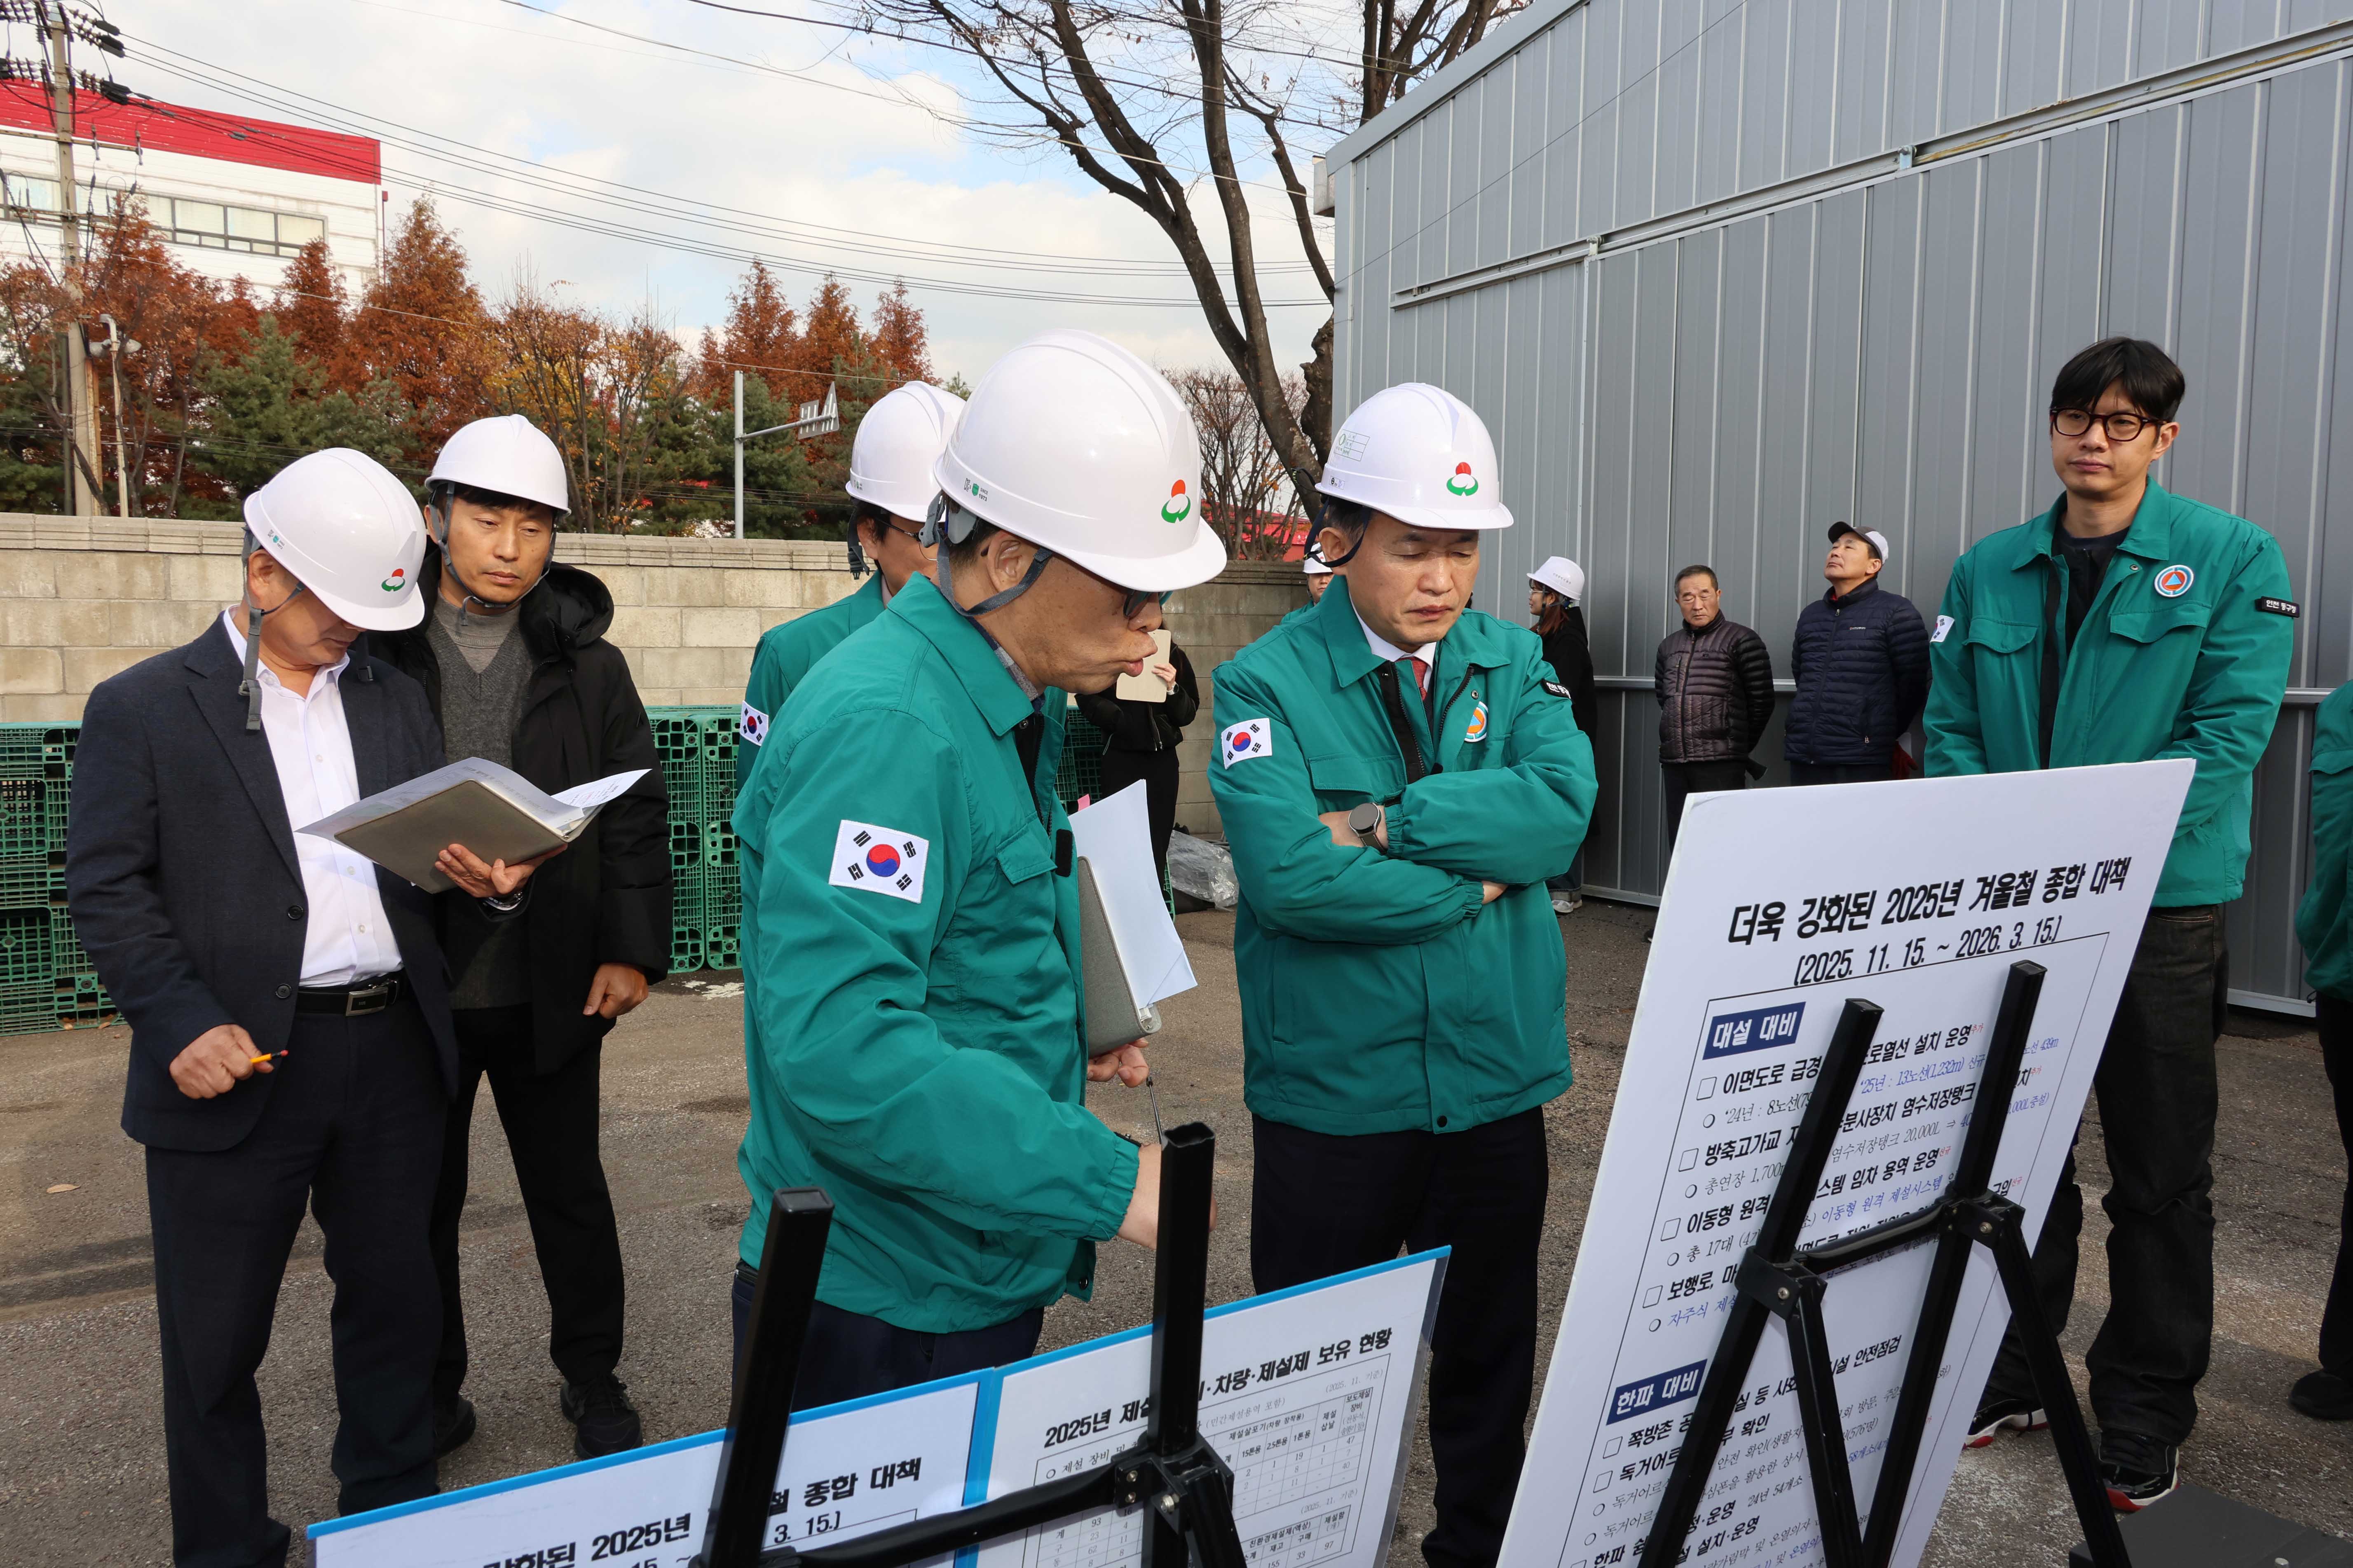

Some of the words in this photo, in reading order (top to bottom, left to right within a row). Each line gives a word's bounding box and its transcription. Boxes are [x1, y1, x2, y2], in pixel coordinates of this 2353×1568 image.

[2266, 600, 2279, 608] 인천
[2281, 603, 2296, 613] 동구청
[1728, 901, 1786, 945] 더욱
[1797, 890, 1877, 938] 강화된
[1881, 879, 1964, 925] 2025년
[1969, 869, 2038, 912] 겨울철
[2042, 863, 2086, 903] 종합
[2090, 857, 2132, 894] 대책
[1867, 943, 1889, 973] 11.
[1903, 937, 1926, 967] 15.
[1955, 925, 2002, 958] 2026.
[2009, 922, 2024, 949] 3.
[1713, 1019, 1753, 1048] 대설
[1759, 1011, 1798, 1041] 대비
[1723, 1064, 1786, 1094] 이면도로
[1791, 1055, 1822, 1081] 급경
[1914, 1031, 1942, 1055] 설치
[1945, 1025, 1972, 1048] 운영
[1968, 1053, 1985, 1070] 신규
[1705, 1129, 1782, 1166] 방축고가교
[1838, 1102, 1897, 1133] 분사장치
[1901, 1083, 1976, 1118] 염수저장탱크
[1705, 1170, 1746, 1195] 총연장
[1832, 1133, 1900, 1163] 염수저장탱크
[1687, 1204, 1734, 1233] 이동형
[1740, 1194, 1772, 1221] 원격
[1814, 1173, 1847, 1199] 스템
[1850, 1165, 1878, 1190] 임차
[1882, 1156, 1910, 1181] 용역
[1912, 1147, 1939, 1172] 운영
[1687, 1245, 1700, 1262] 총
[1706, 1235, 1734, 1257] 17대
[1822, 1201, 1856, 1223] 이동형
[1862, 1193, 1885, 1212] 원격
[1889, 1175, 1943, 1203] 제설시스템
[1667, 1271, 1714, 1301] 보행로,
[1044, 1408, 1111, 1448] 2025년
[1119, 1397, 1149, 1424] 제설
[1198, 1350, 1310, 1401] ·차량·제설제
[1317, 1340, 1351, 1366] 보유
[1359, 1327, 1392, 1354] 현황
[1616, 1383, 1655, 1415] 한파
[1662, 1369, 1699, 1399] 대비
[1628, 1420, 1674, 1448] 쪽방촌
[1754, 1385, 1770, 1405] 등
[1853, 1334, 1902, 1368] 안전점검
[1062, 1458, 1083, 1473] 제설
[1619, 1446, 1682, 1481] 독거어르
[1741, 1413, 1770, 1436] 확인
[591, 1513, 691, 1561] 2025년
[804, 1472, 858, 1507] 종합
[870, 1457, 922, 1489] 대책
[1612, 1478, 1670, 1509] 독거어르
[774, 1524, 791, 1544] 3.
[1056, 1529, 1065, 1540] 계
[1092, 1517, 1102, 1528] 93
[1603, 1510, 1654, 1538] 독거어르
